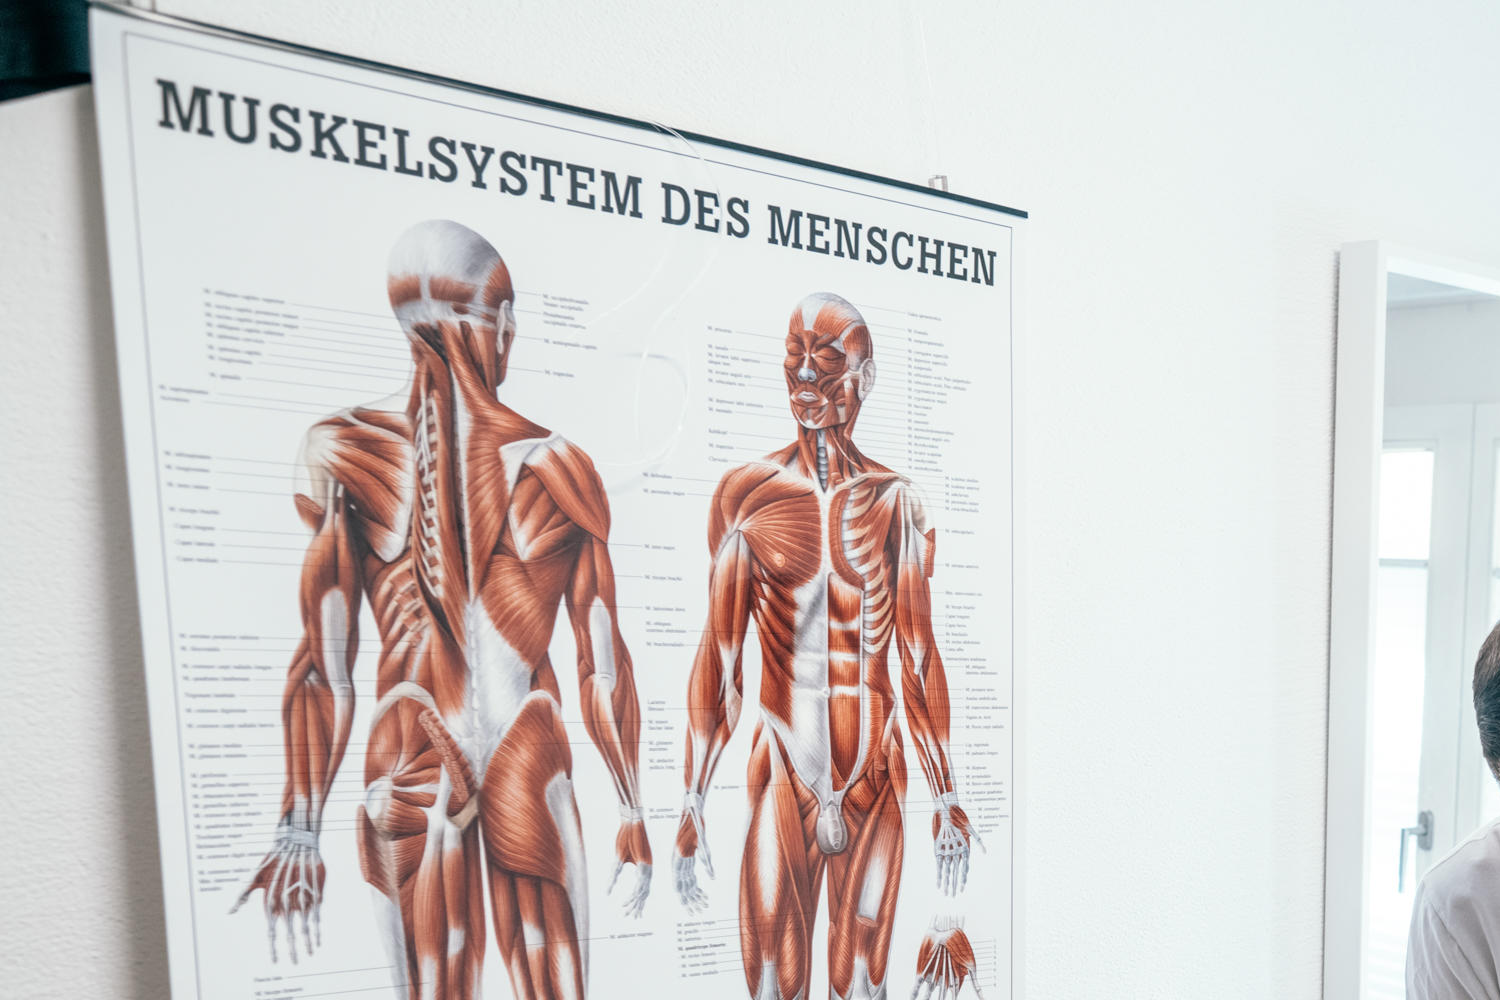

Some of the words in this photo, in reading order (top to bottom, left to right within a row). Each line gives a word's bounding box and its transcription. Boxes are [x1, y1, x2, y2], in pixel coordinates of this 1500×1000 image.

[156, 78, 643, 219] MUSKELSYSTEM
[661, 182, 750, 239] DES
[767, 204, 997, 287] MENSCHEN
